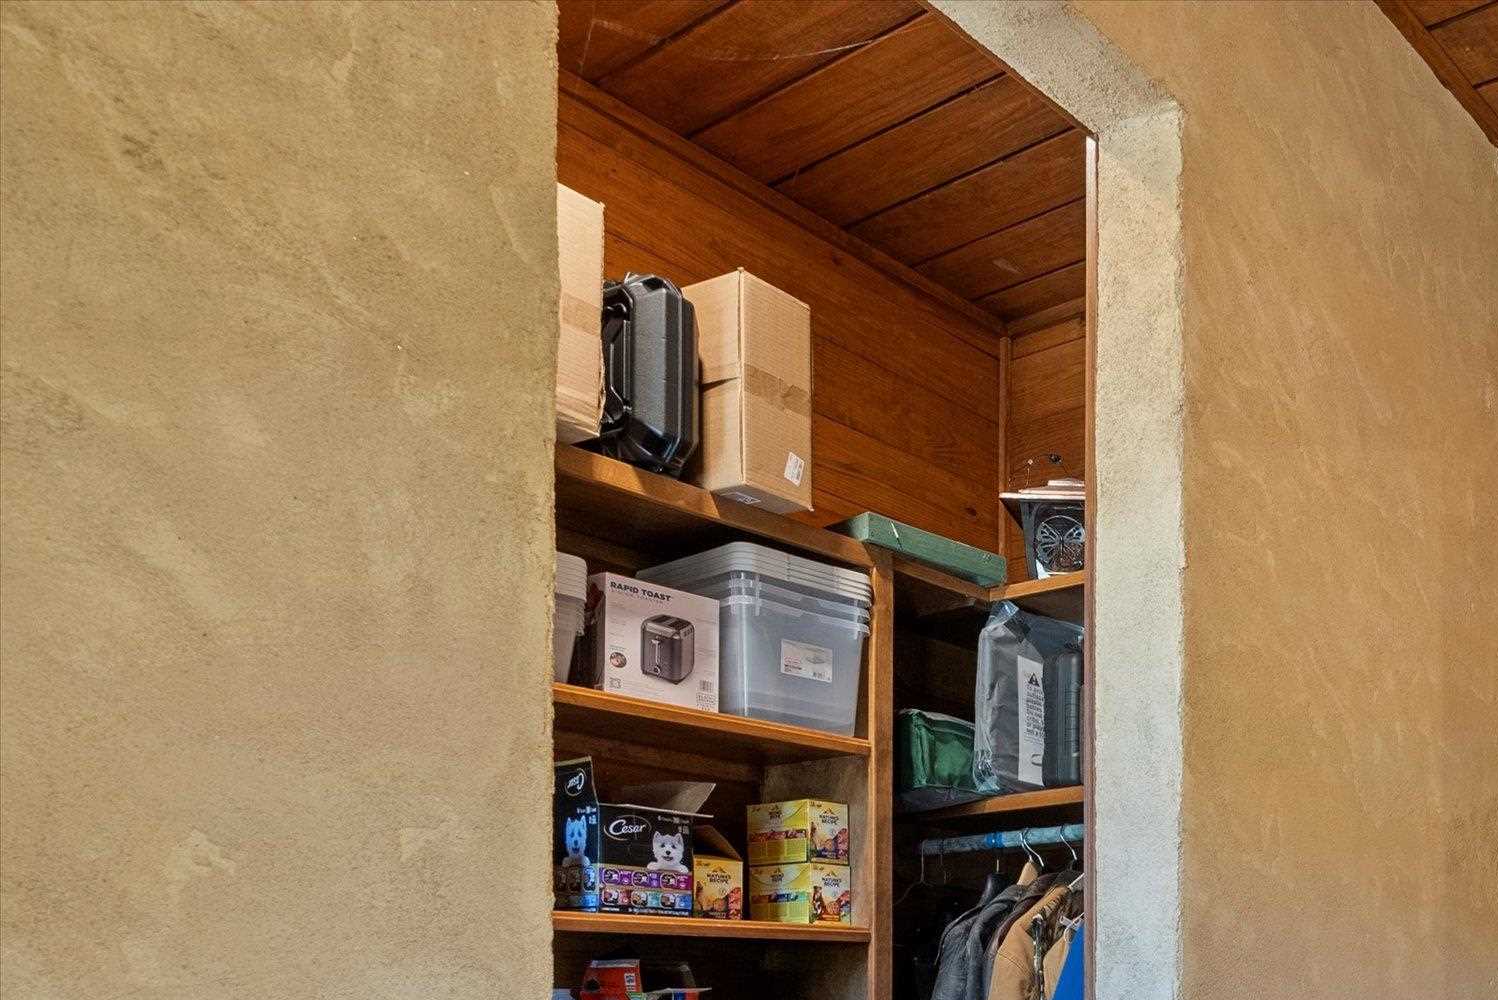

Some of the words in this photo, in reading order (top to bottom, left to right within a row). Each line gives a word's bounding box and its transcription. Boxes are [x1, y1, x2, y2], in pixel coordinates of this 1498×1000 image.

[610, 581, 639, 594] RAPID
[641, 589, 672, 602] TOAST
[609, 819, 646, 836] Cesar
